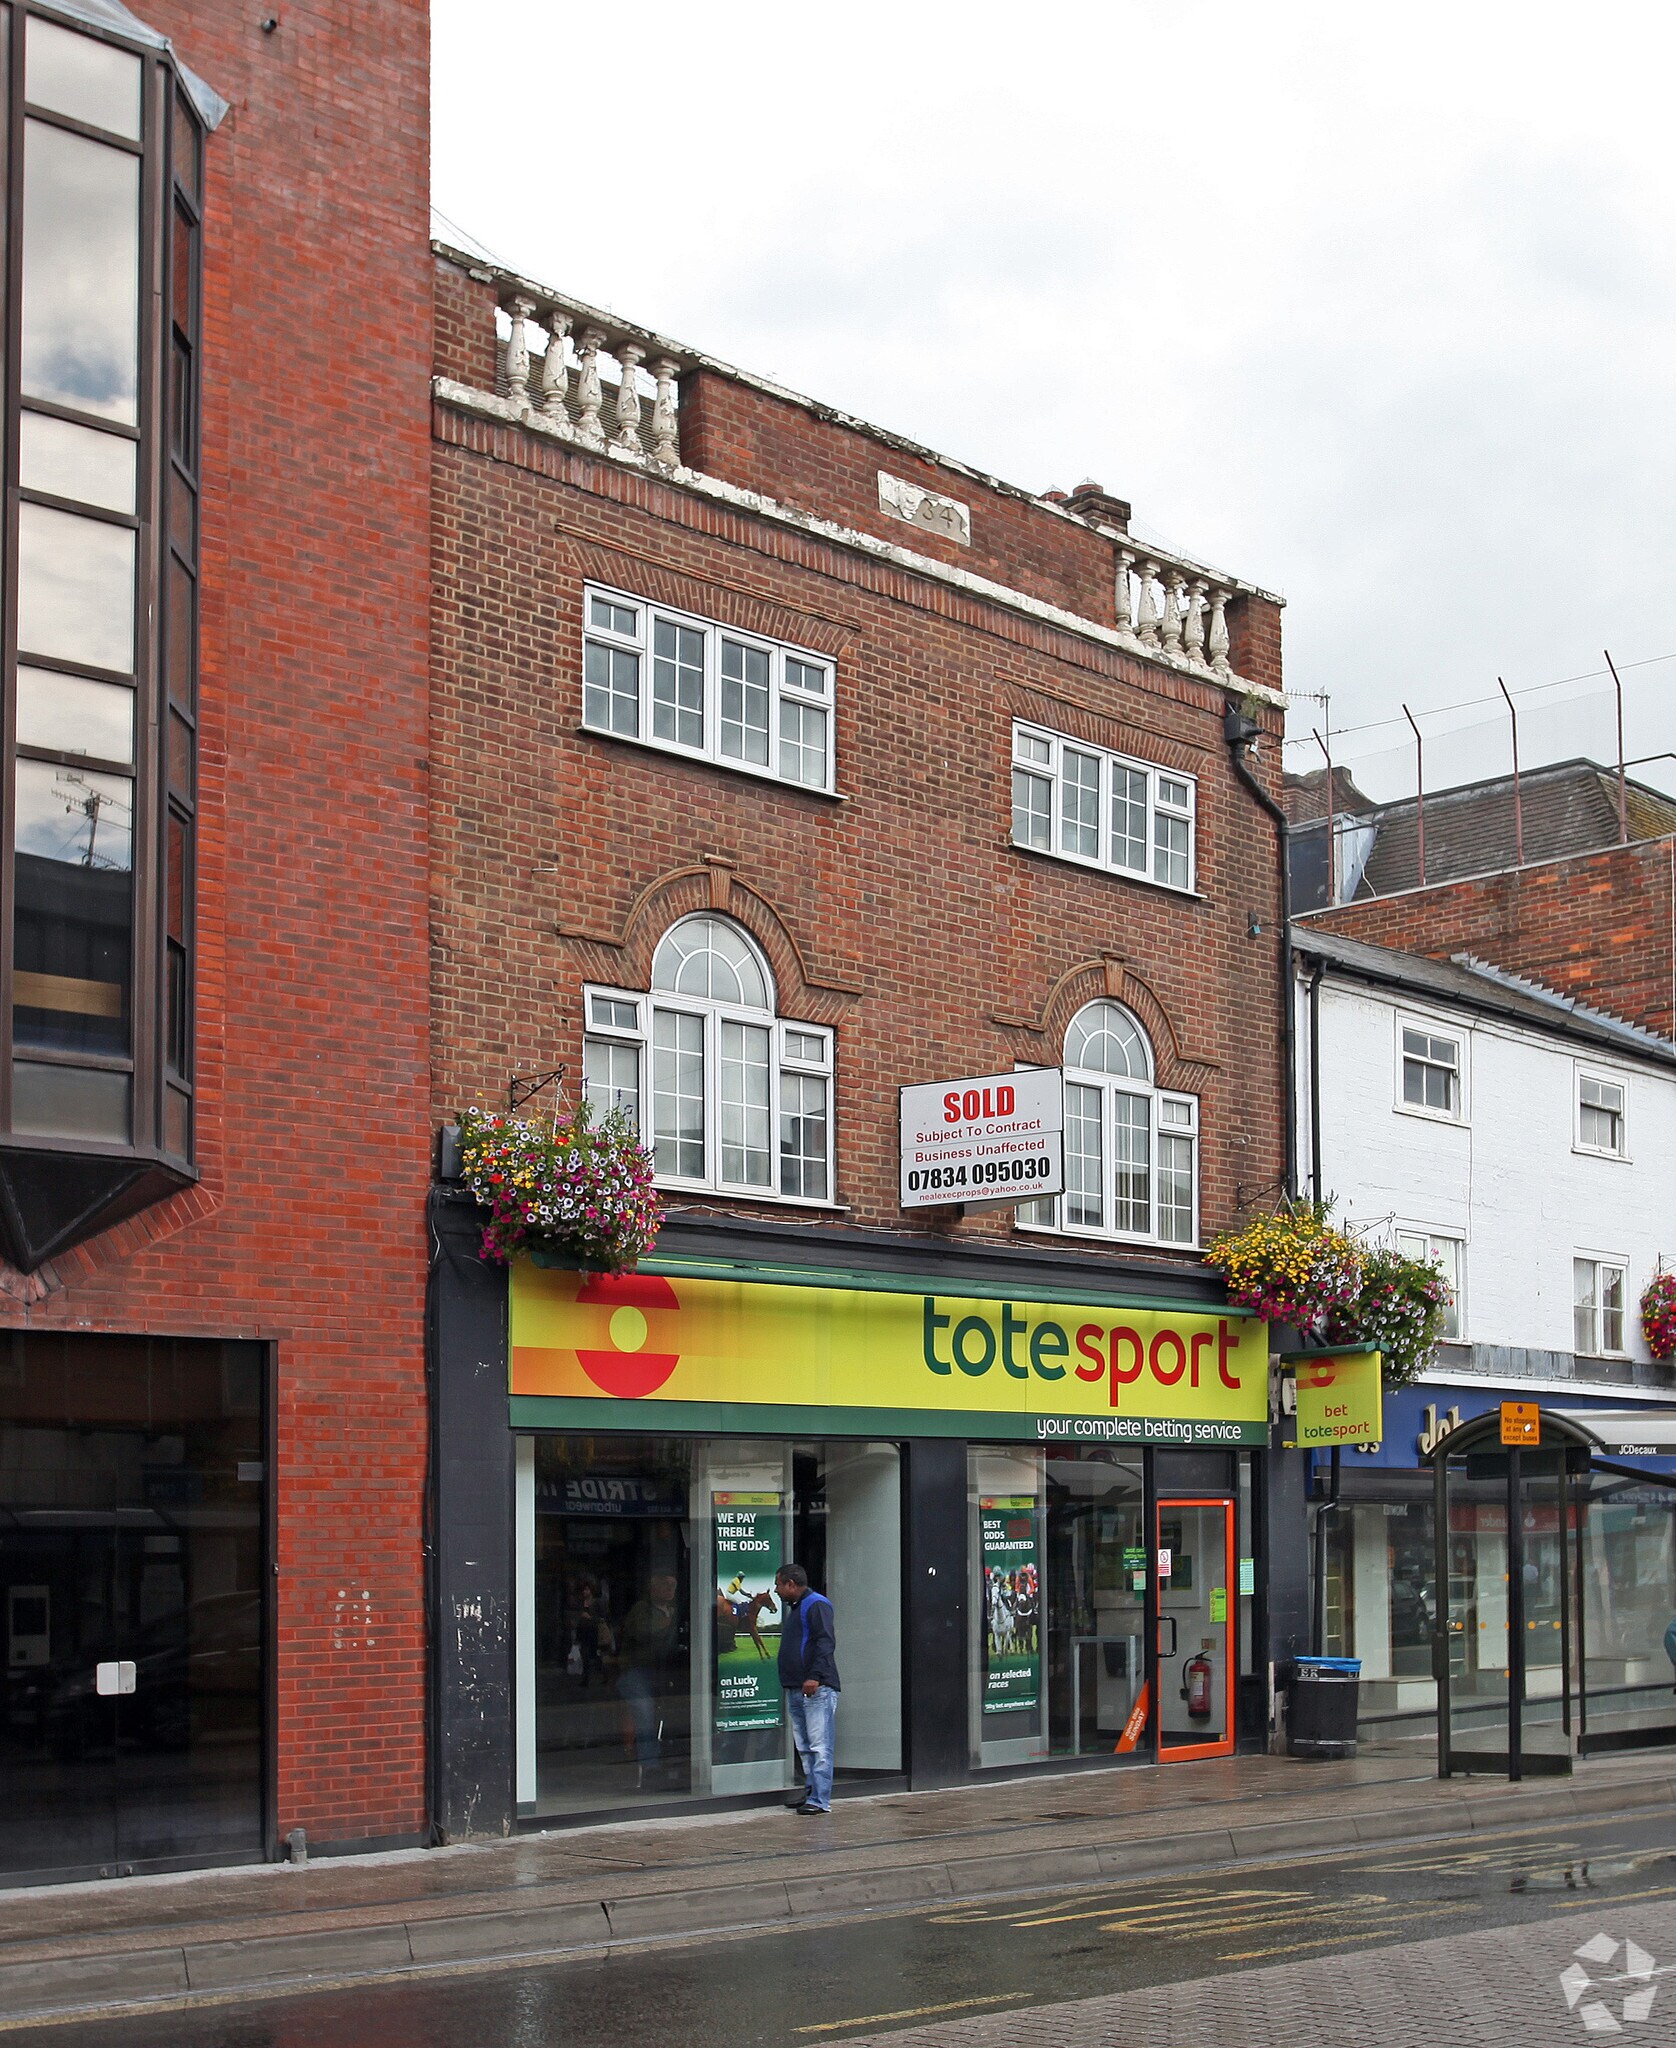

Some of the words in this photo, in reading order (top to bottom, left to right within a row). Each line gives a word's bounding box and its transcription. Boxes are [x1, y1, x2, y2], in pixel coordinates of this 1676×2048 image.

[943, 1085, 1015, 1124] SOLD
[916, 1128, 963, 1144] Subject
[966, 1126, 982, 1137] To
[986, 1119, 1041, 1134] Contract
[915, 1149, 972, 1162] Business
[976, 1139, 1045, 1156] Unaffected
[908, 1166, 967, 1191] 07834
[972, 1157, 1050, 1185] 095030
[919, 1182, 1044, 1201] nealexecprops@yahoo.co.uk
[923, 1296, 1241, 1408] totesport
[1324, 1404, 1348, 1418] bet
[1513, 1417, 1536, 1425] stopping
[1036, 1418, 1072, 1440] your
[1074, 1417, 1142, 1440] complete
[1144, 1418, 1192, 1443] betting
[1194, 1420, 1242, 1440] service
[1304, 1421, 1370, 1439] totesport
[1503, 1435, 1521, 1443] except
[1618, 1444, 1657, 1455] JCDecaux
[717, 1513, 734, 1523] WE
[737, 1513, 757, 1523] PAY
[983, 1520, 1001, 1529] BEST
[717, 1527, 754, 1537] TREBLE
[984, 1531, 1005, 1540] ODDS
[718, 1540, 737, 1551] THE
[739, 1540, 770, 1551] ODDS
[984, 1541, 1034, 1550] GUARANTEED
[1001, 1668, 1031, 1679] selected
[720, 1678, 732, 1686] on
[733, 1675, 758, 1687] Lucky
[988, 1681, 1009, 1689] races
[739, 1718, 764, 1727] anywhere
[765, 1717, 780, 1725] else?
[1129, 1710, 1145, 1742] SUNDAY
